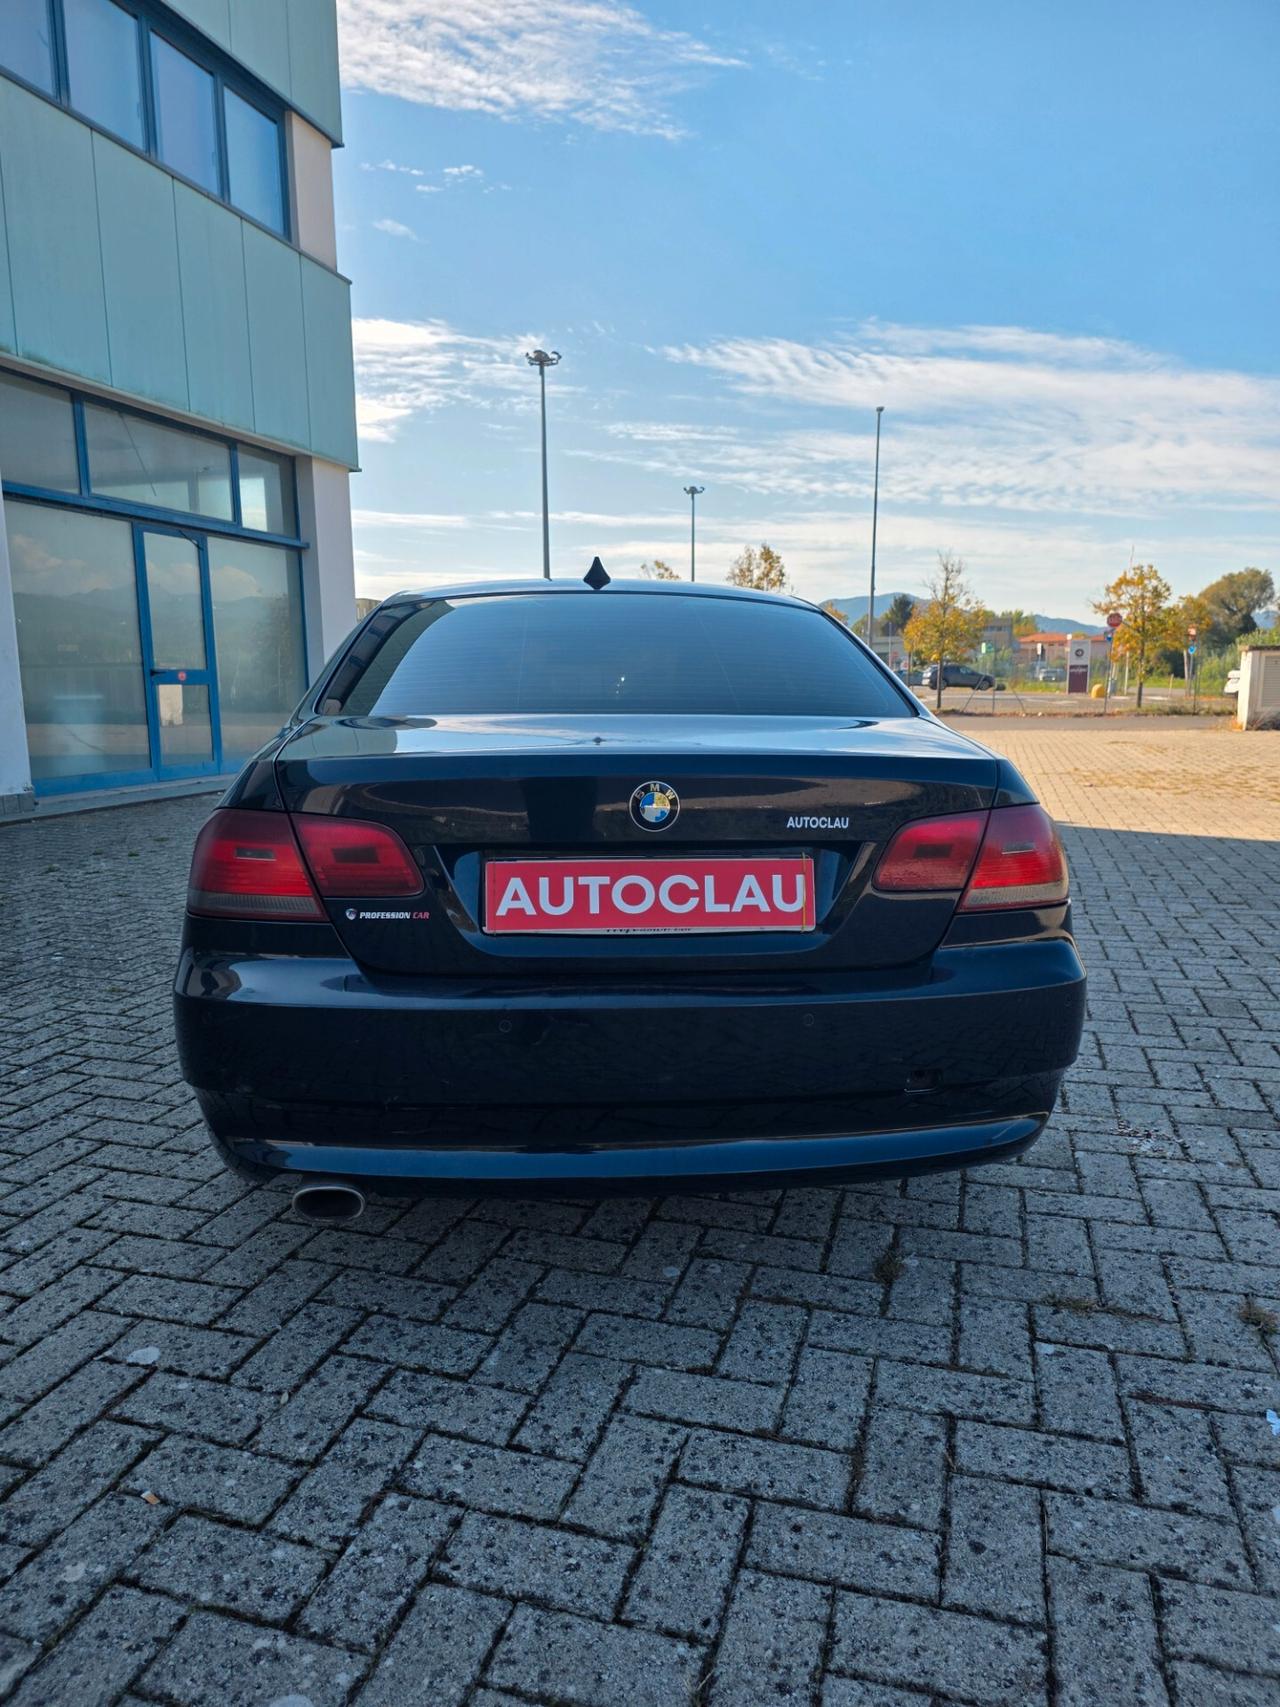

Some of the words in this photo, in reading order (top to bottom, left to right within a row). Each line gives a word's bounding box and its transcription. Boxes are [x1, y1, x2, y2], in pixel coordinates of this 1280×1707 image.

[634, 783, 676, 800] BMW
[786, 816, 850, 829] AUTOCLAU
[495, 874, 805, 917] AUTOCLAU
[359, 911, 411, 919] PROFESSION
[412, 911, 430, 919] CAR
